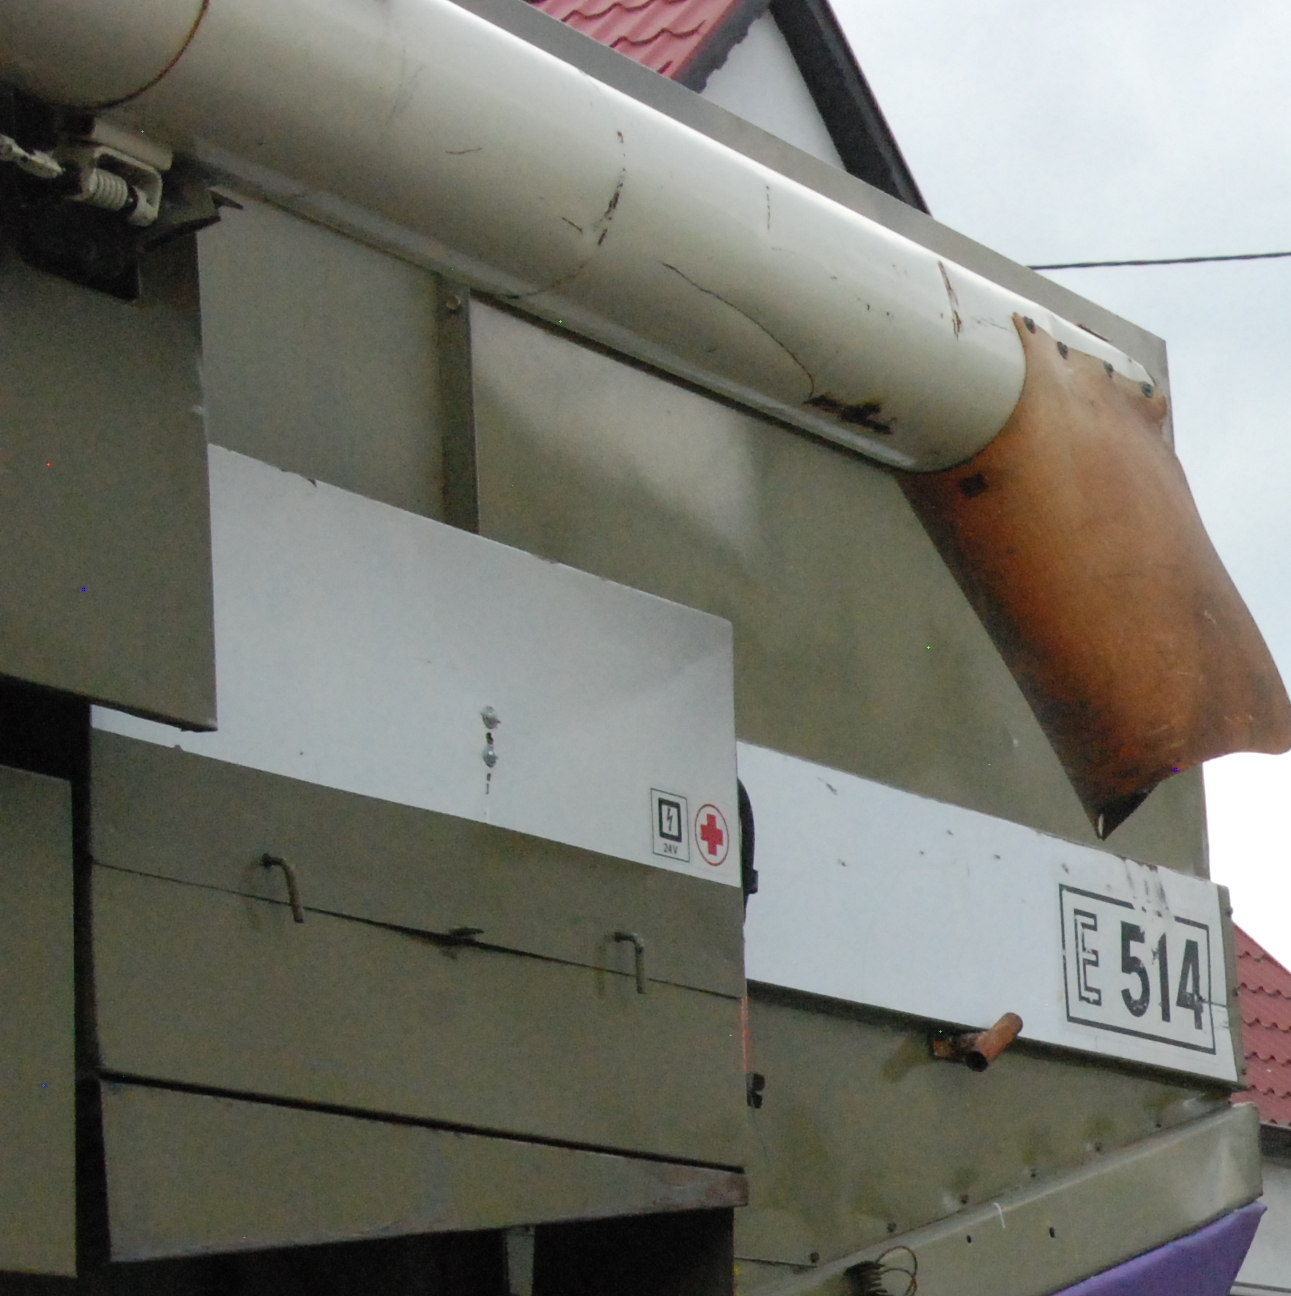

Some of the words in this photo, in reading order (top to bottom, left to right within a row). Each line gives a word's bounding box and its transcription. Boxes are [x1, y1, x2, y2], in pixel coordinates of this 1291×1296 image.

[663, 842, 678, 854] 24V
[1073, 908, 1102, 1006] E
[1120, 920, 1204, 1030] 514
